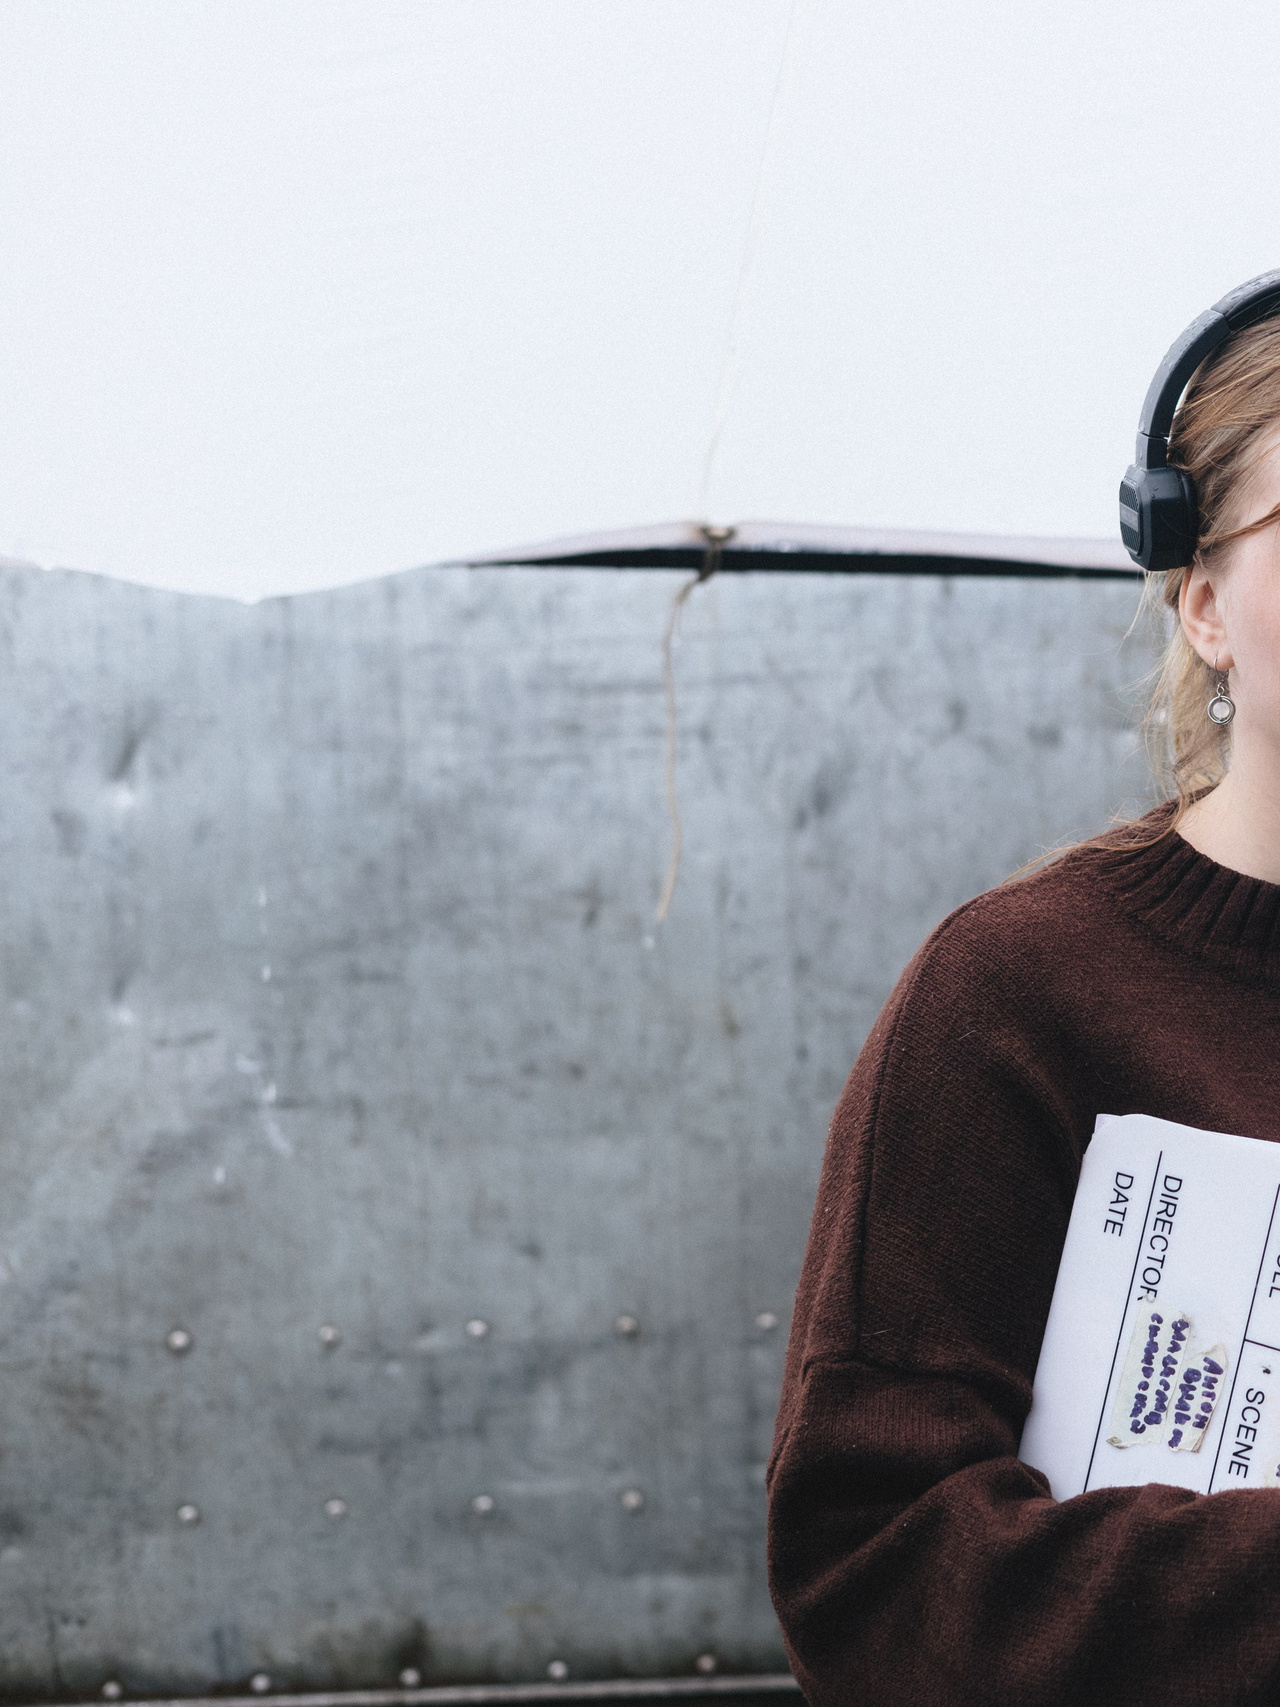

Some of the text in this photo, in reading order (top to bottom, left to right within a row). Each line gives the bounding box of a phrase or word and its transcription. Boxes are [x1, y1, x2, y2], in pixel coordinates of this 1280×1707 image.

[1103, 1171, 1135, 1237] DATE
[1136, 1174, 1183, 1303] DIRECTOR
[1227, 1387, 1266, 1479] SCENE
